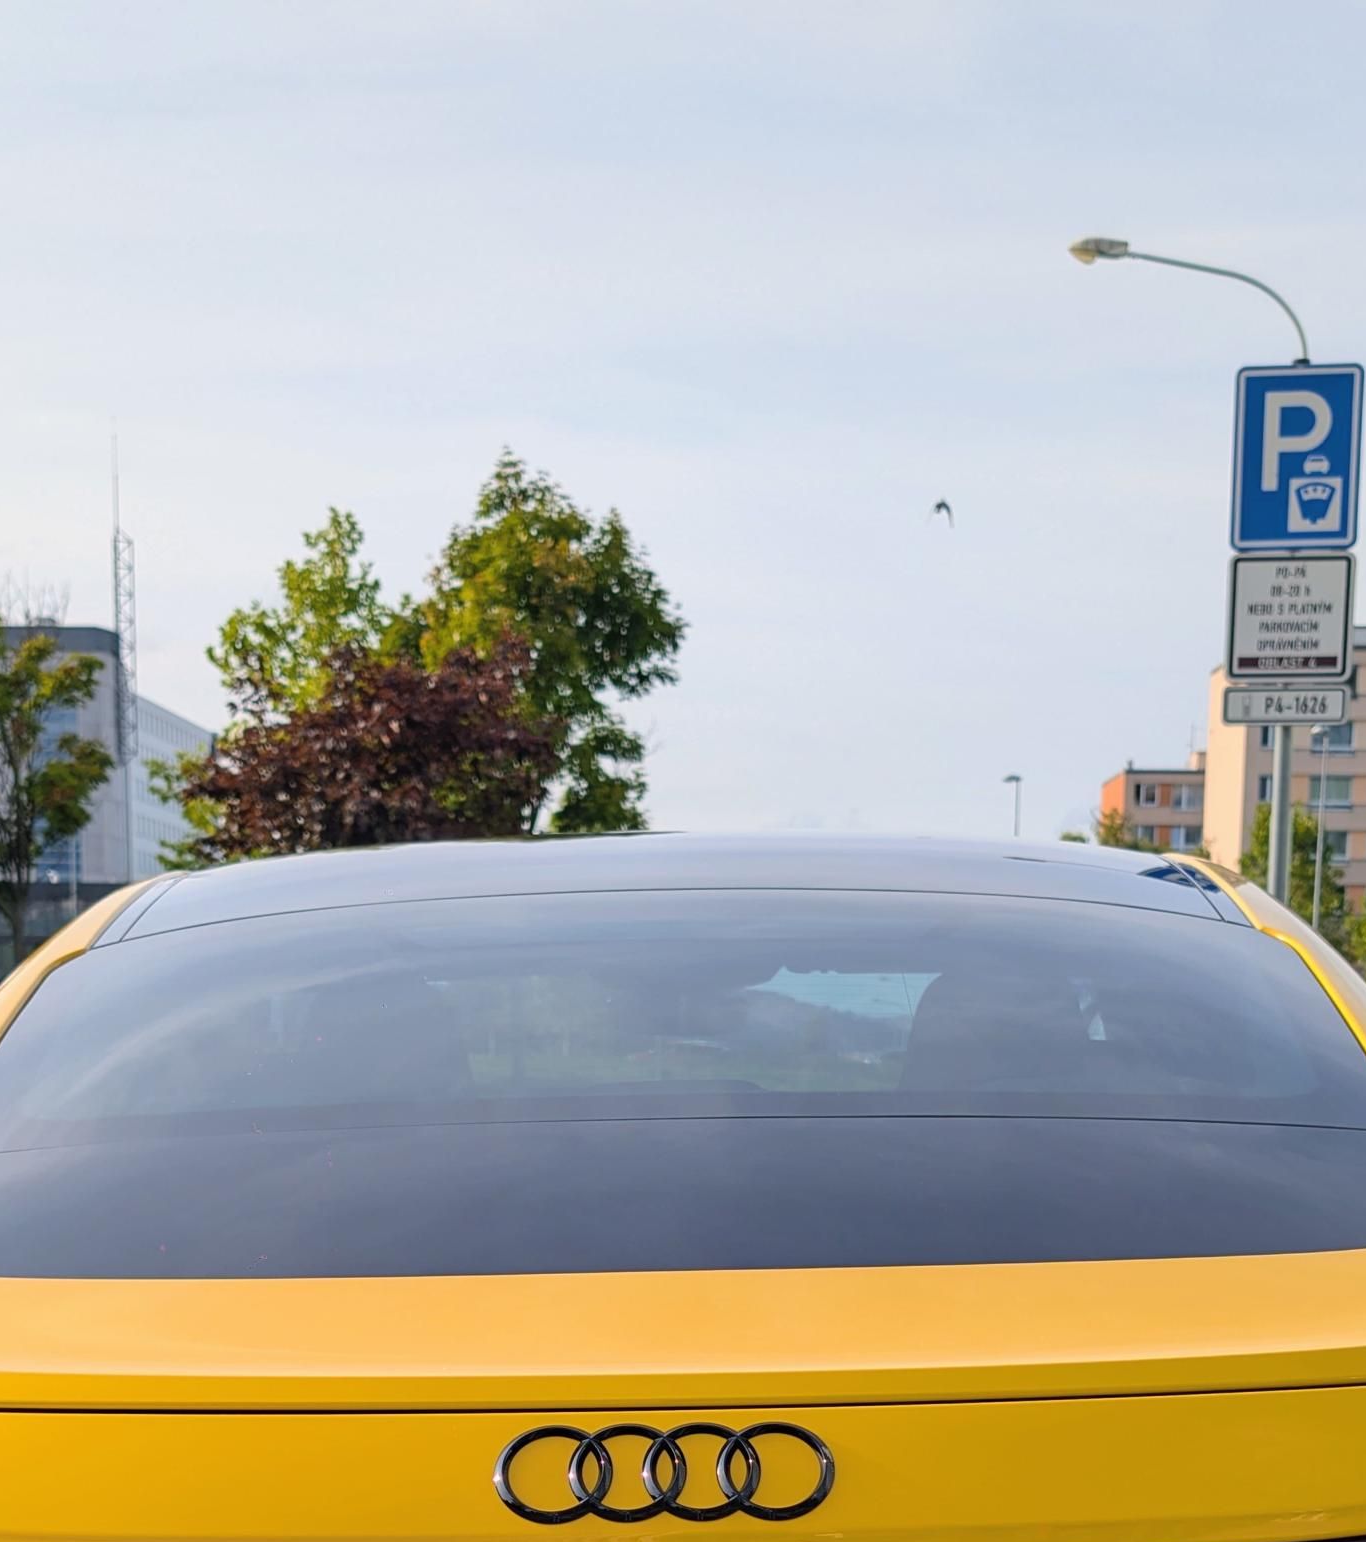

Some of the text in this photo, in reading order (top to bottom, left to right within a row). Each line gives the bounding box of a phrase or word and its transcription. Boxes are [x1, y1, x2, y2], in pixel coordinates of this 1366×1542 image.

[1261, 390, 1333, 492] P
[1247, 599, 1333, 616] NEBO S PLATNÝM
[1258, 618, 1319, 633] PARKOVACÍM
[1257, 635, 1319, 651] OPRÁVNĚNÍM
[1265, 696, 1328, 714] P4-1626
